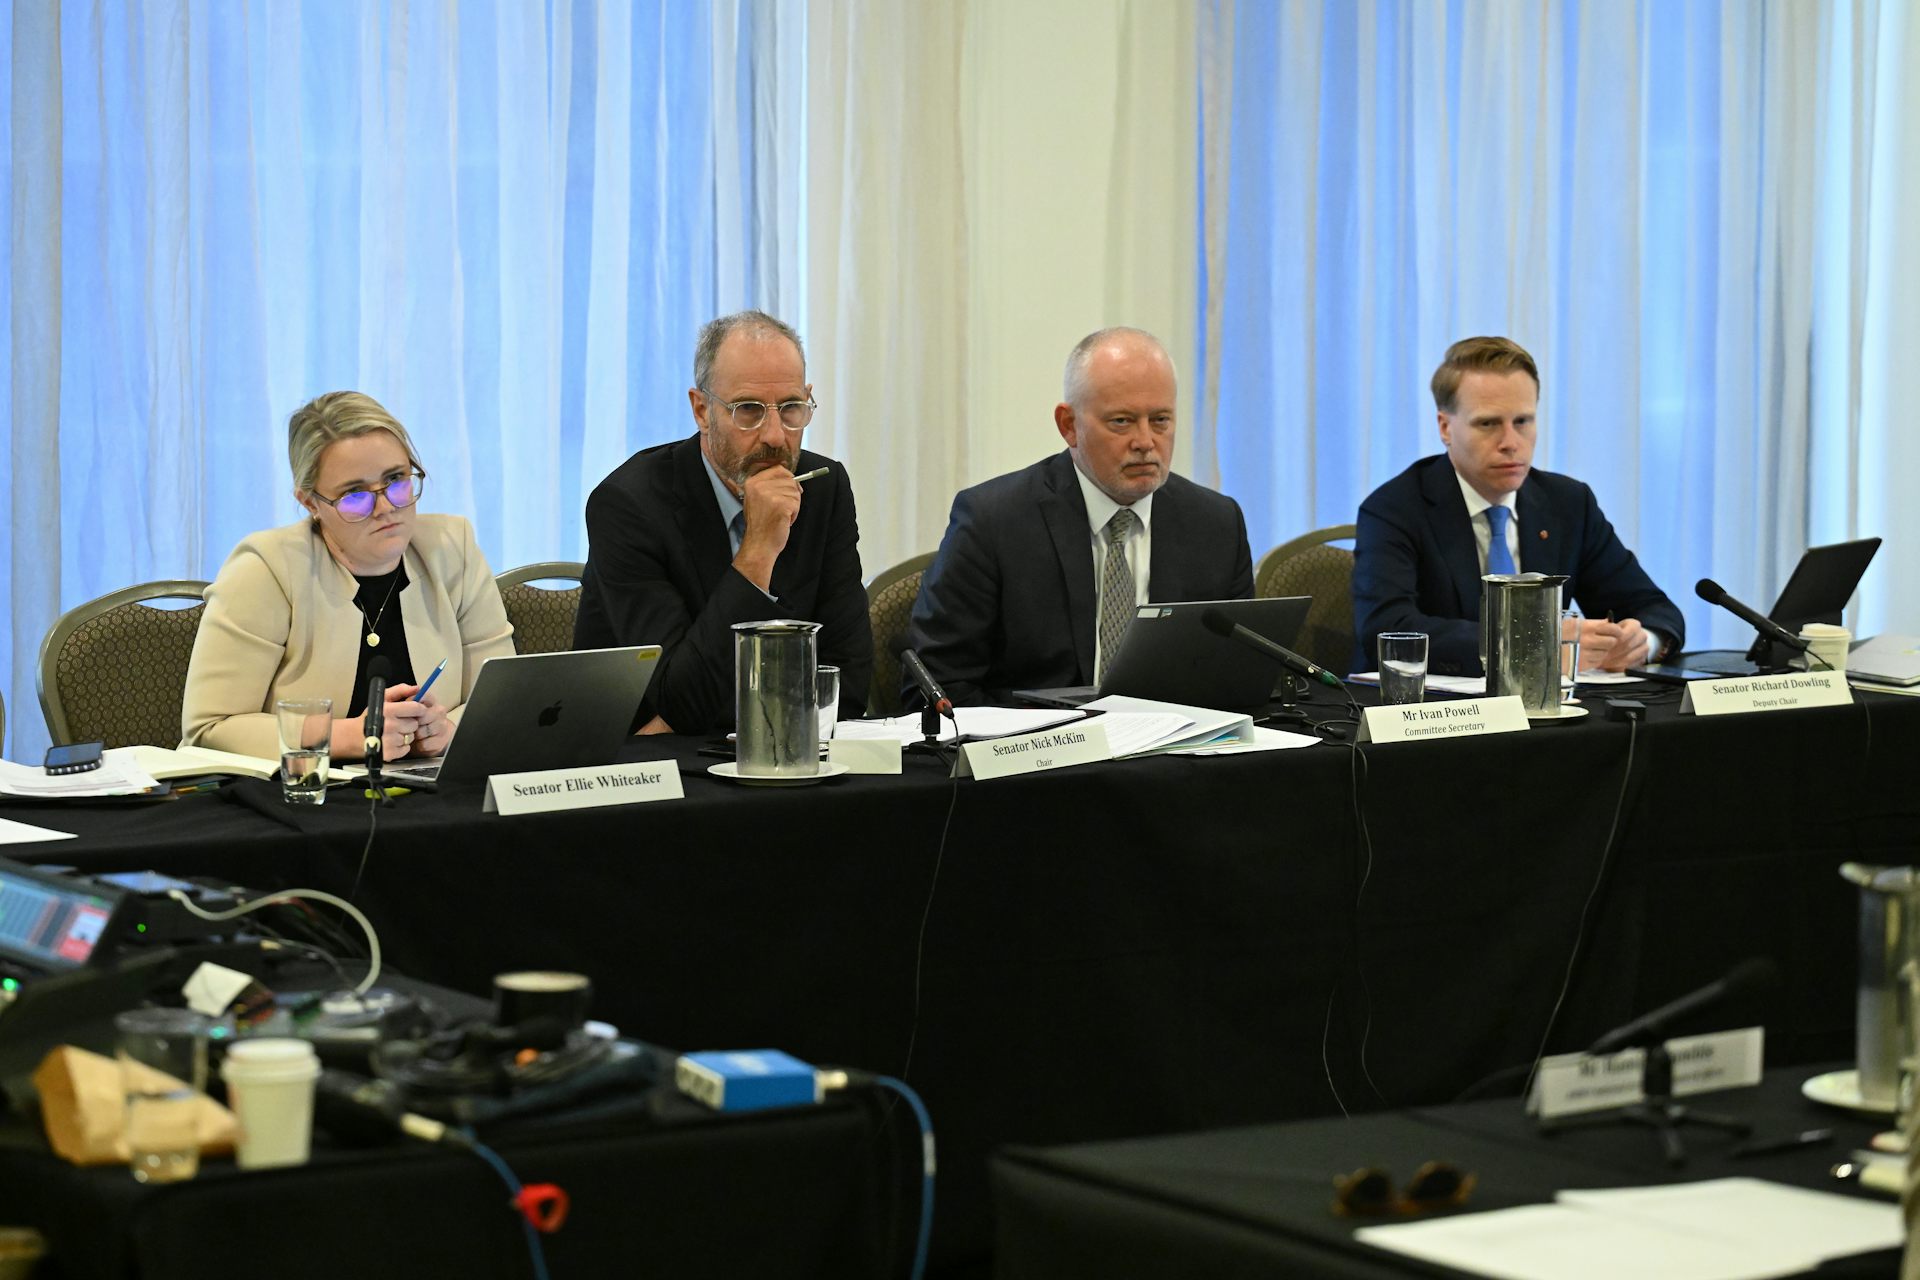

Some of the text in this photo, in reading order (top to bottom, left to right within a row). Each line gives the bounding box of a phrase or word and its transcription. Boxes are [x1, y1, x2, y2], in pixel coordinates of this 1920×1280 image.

[1712, 677, 1831, 695] Senator Richard Dowling
[1752, 697, 1799, 708] Deputy Chair
[1402, 704, 1480, 722] Mr Ivan Powell
[1404, 722, 1486, 737] Committee Secretary
[992, 732, 1086, 757] Senator Nick McKim
[1036, 758, 1053, 769] Chair
[513, 771, 662, 797] Senator Ellie Whiteaker
